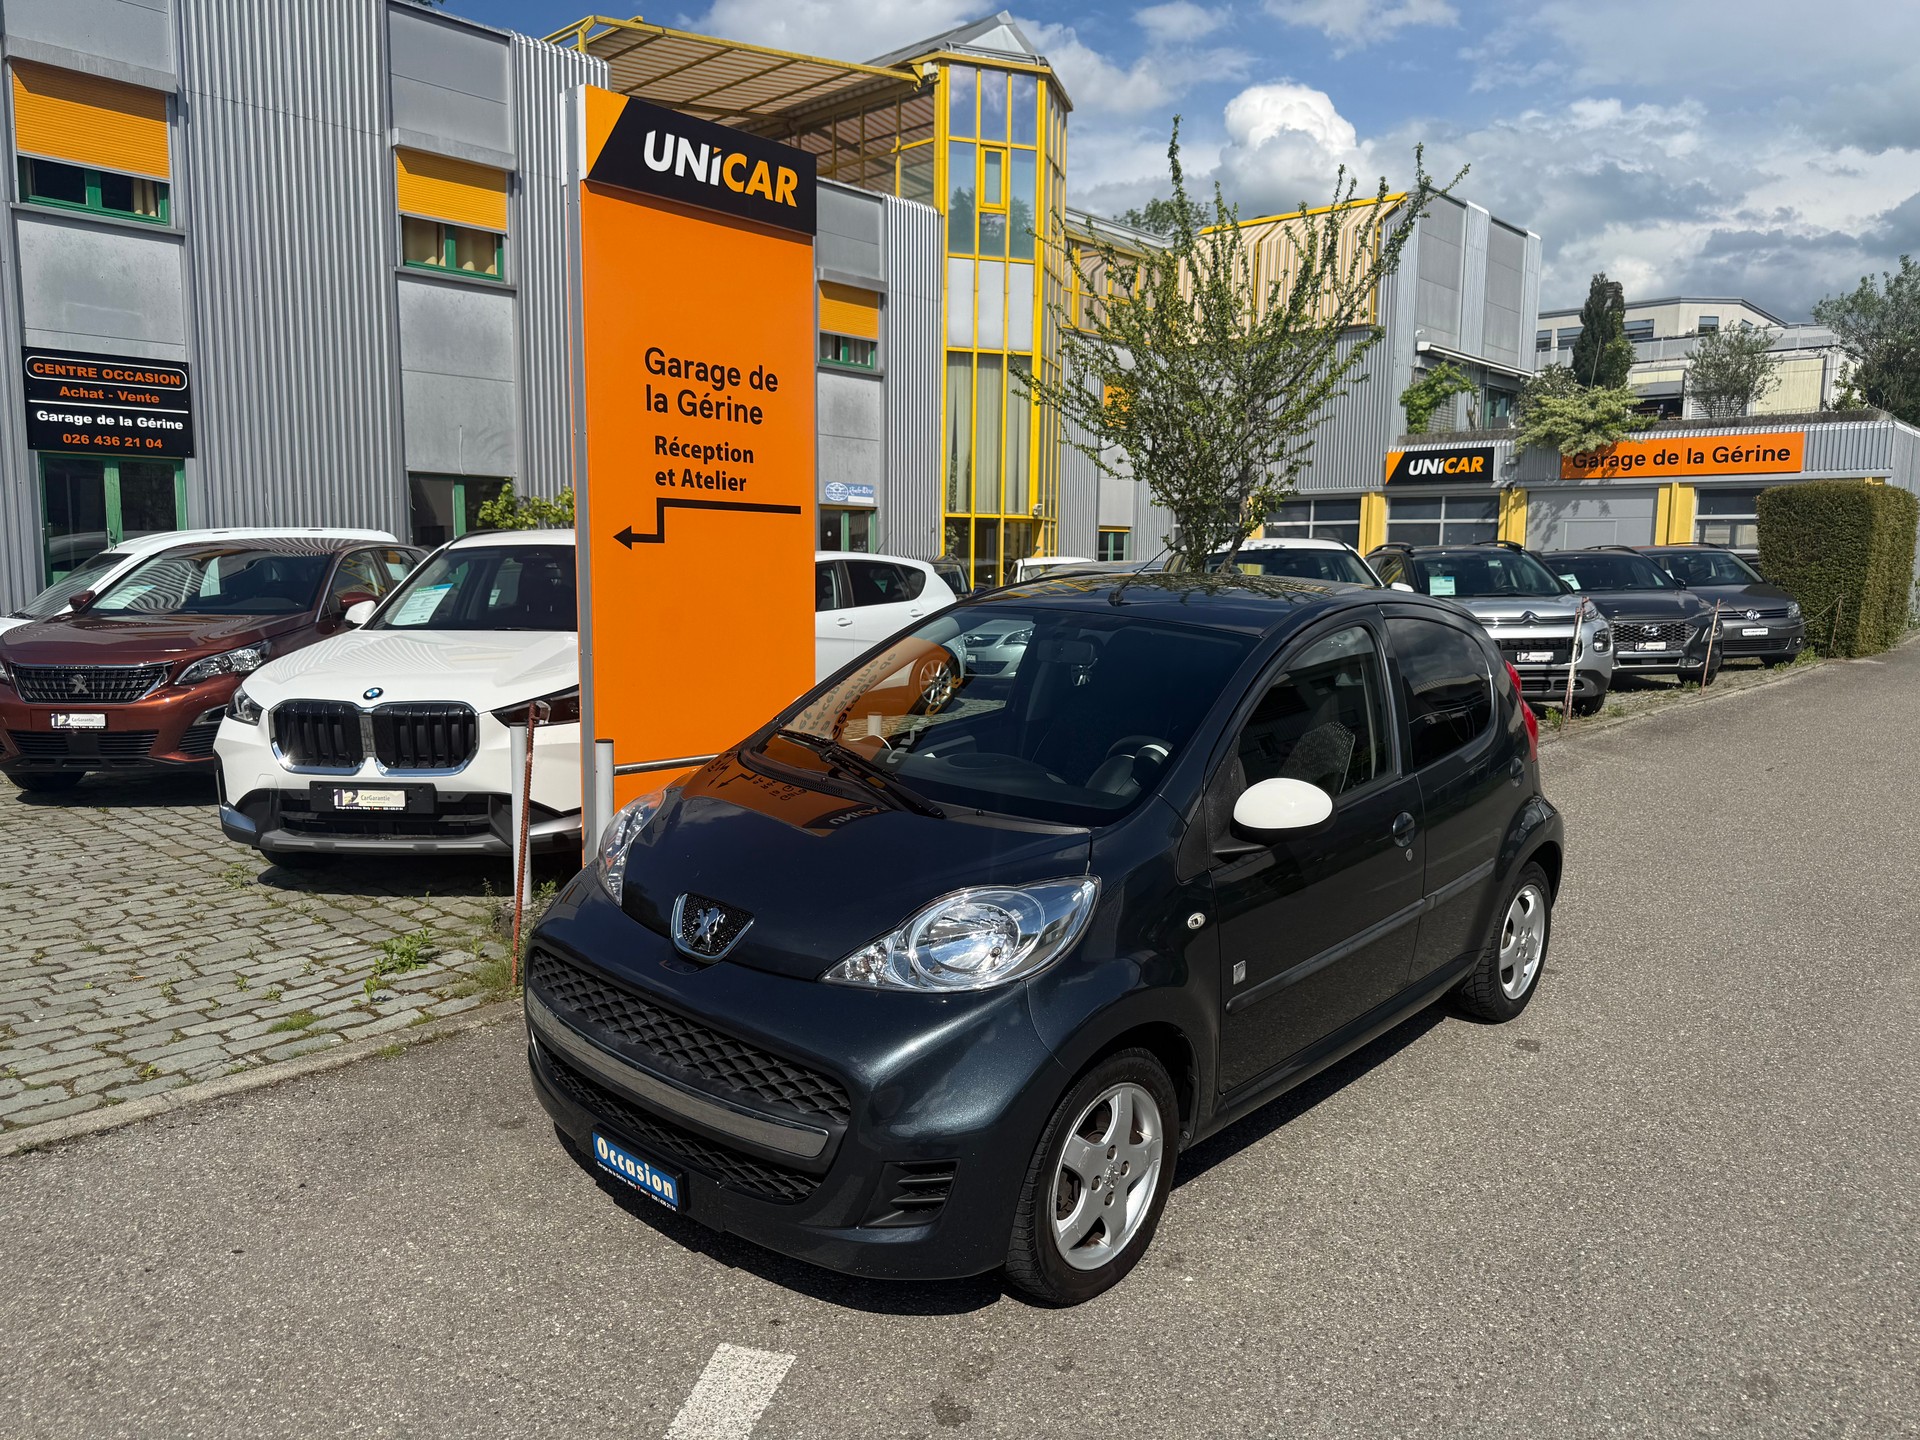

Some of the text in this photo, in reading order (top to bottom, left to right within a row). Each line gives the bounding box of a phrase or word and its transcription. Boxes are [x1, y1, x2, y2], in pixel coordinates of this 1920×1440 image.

[33, 362, 181, 385] CENTRE OCCASION
[644, 346, 778, 392] Garage de
[59, 386, 104, 400] Achat
[117, 390, 160, 404] Vente
[646, 384, 763, 425] la Gérine
[36, 410, 184, 430] Garage de la Gérine
[63, 433, 163, 449] 026 436 21 04
[654, 435, 754, 465] Réception
[1572, 445, 1791, 471] Garage de la Gérine
[655, 468, 747, 492] et Atelier
[360, 794, 391, 802] CarGarantie
[597, 1136, 674, 1200] Occasion
